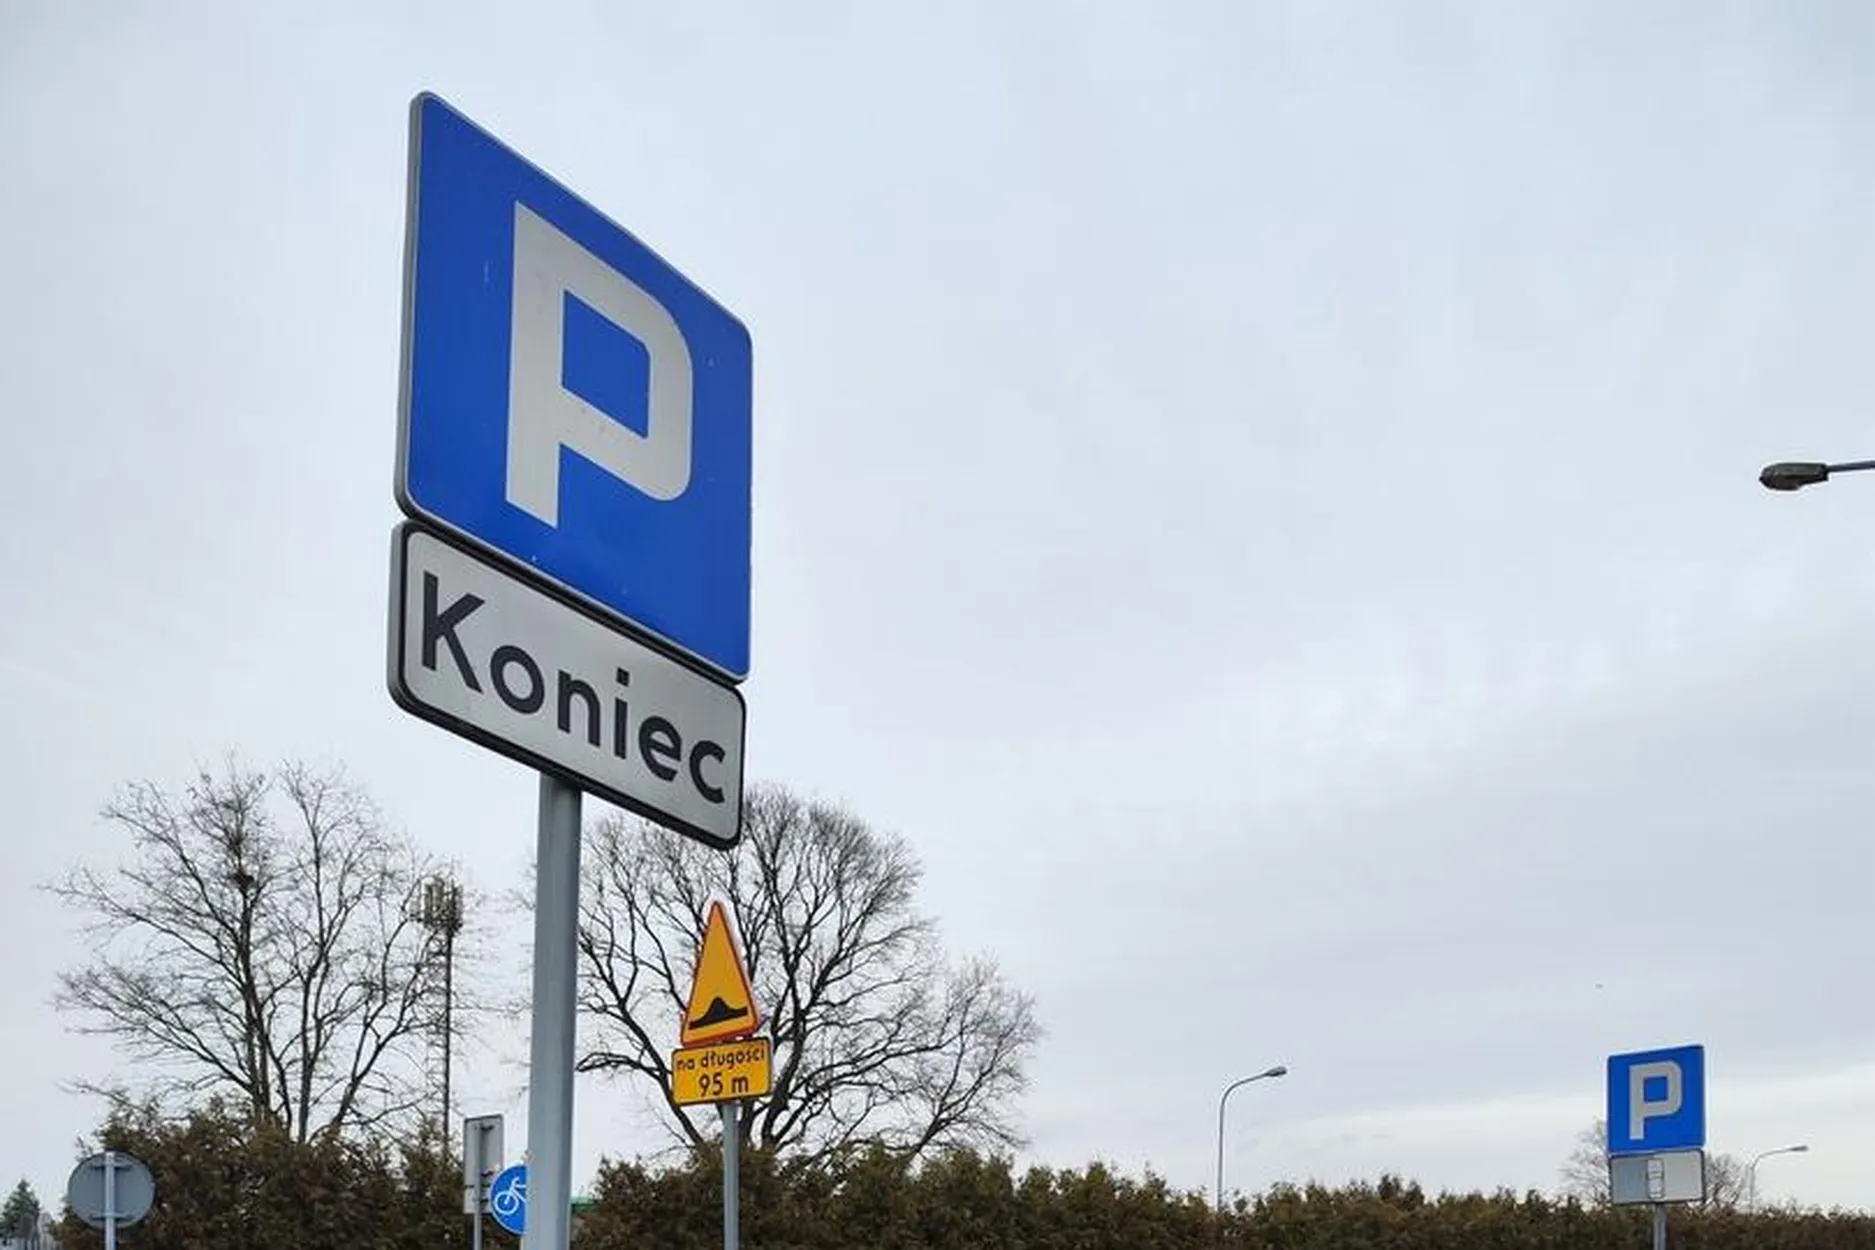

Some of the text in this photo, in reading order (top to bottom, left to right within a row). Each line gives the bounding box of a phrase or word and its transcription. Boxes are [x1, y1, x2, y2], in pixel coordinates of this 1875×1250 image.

[505, 200, 693, 530] P
[421, 571, 728, 805] Koniec
[677, 1043, 765, 1070] na długości
[699, 1073, 749, 1096] 95 m
[1629, 1061, 1682, 1140] P
